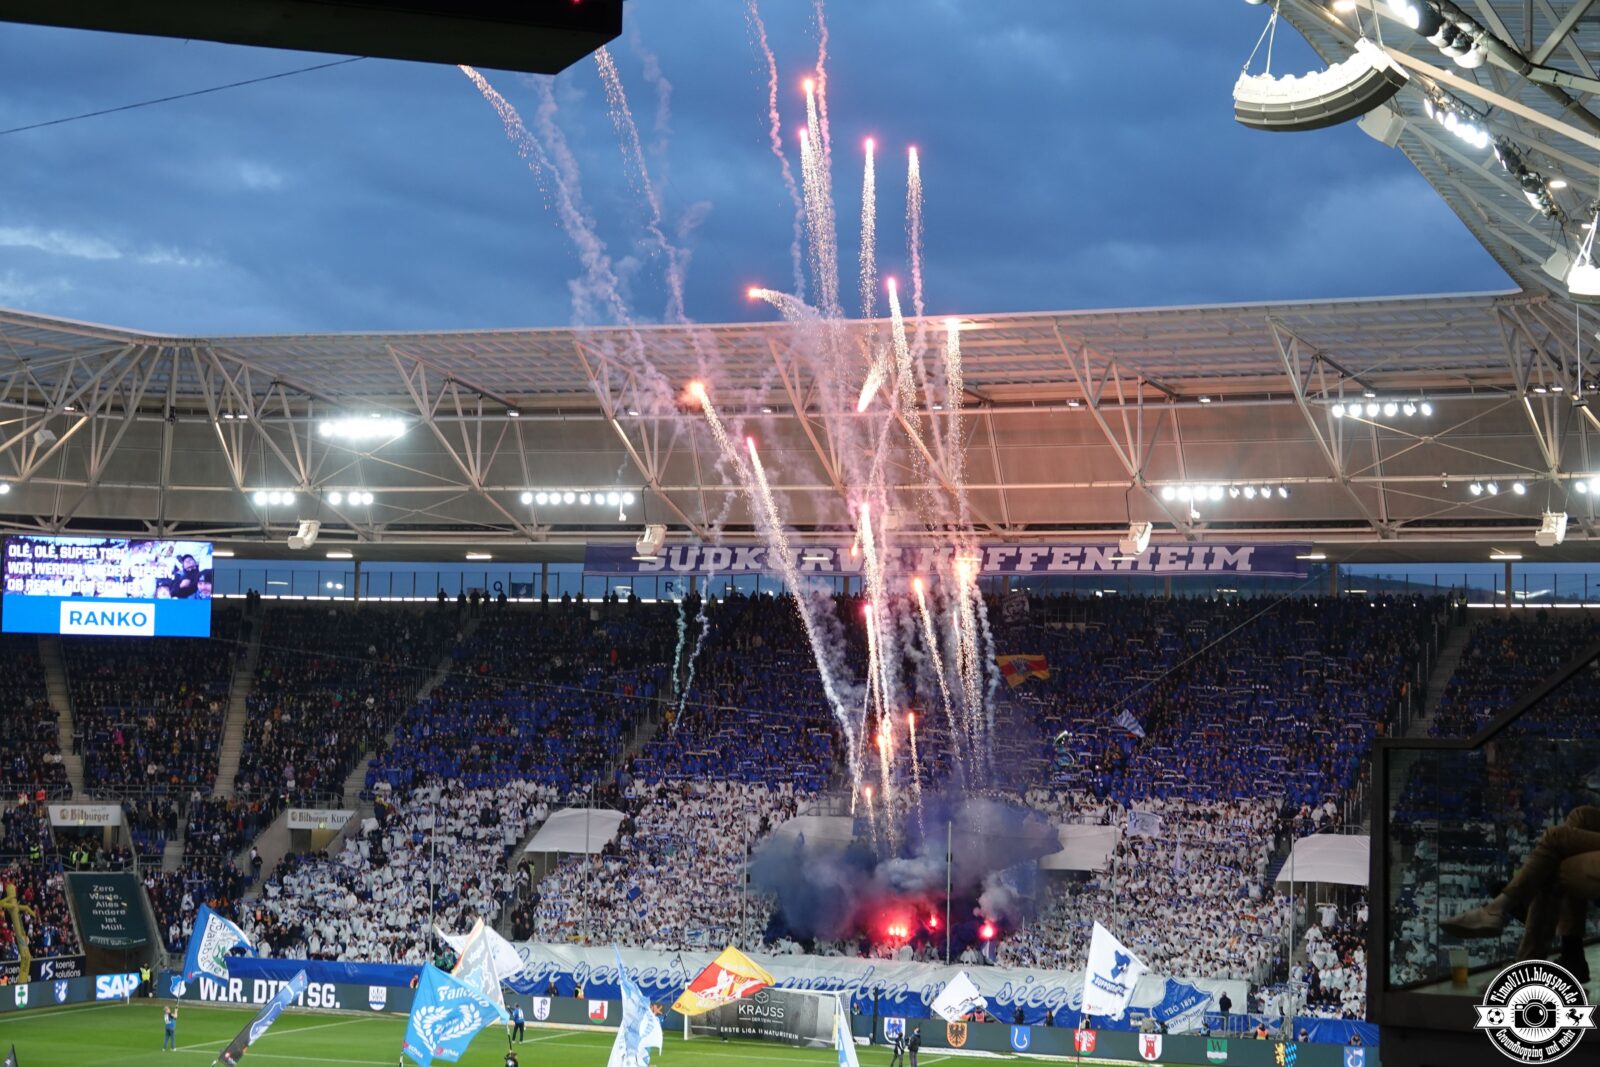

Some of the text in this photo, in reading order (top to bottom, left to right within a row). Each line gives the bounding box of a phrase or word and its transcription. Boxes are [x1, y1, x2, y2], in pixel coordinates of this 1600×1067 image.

[60, 547, 97, 559] SUPER
[8, 561, 33, 574] WIR
[34, 562, 82, 575] WERDEN
[7, 578, 24, 591] OB
[493, 581, 504, 592] Q
[664, 581, 674, 592] R
[69, 610, 148, 628] RANKO
[70, 808, 110, 823] Bitburger
[331, 813, 352, 824] Kurv
[92, 908, 126, 916] andere
[101, 923, 126, 931] Müll.
[55, 960, 76, 970] koenig
[5, 966, 20, 977] koen
[55, 969, 81, 979] solutions
[96, 974, 138, 999] SAP
[1181, 996, 1196, 1010] 1899
[738, 1004, 785, 1018] KRAUSS
[720, 1026, 740, 1034] ERSTE
[764, 1030, 799, 1040] NATURSTEIN
